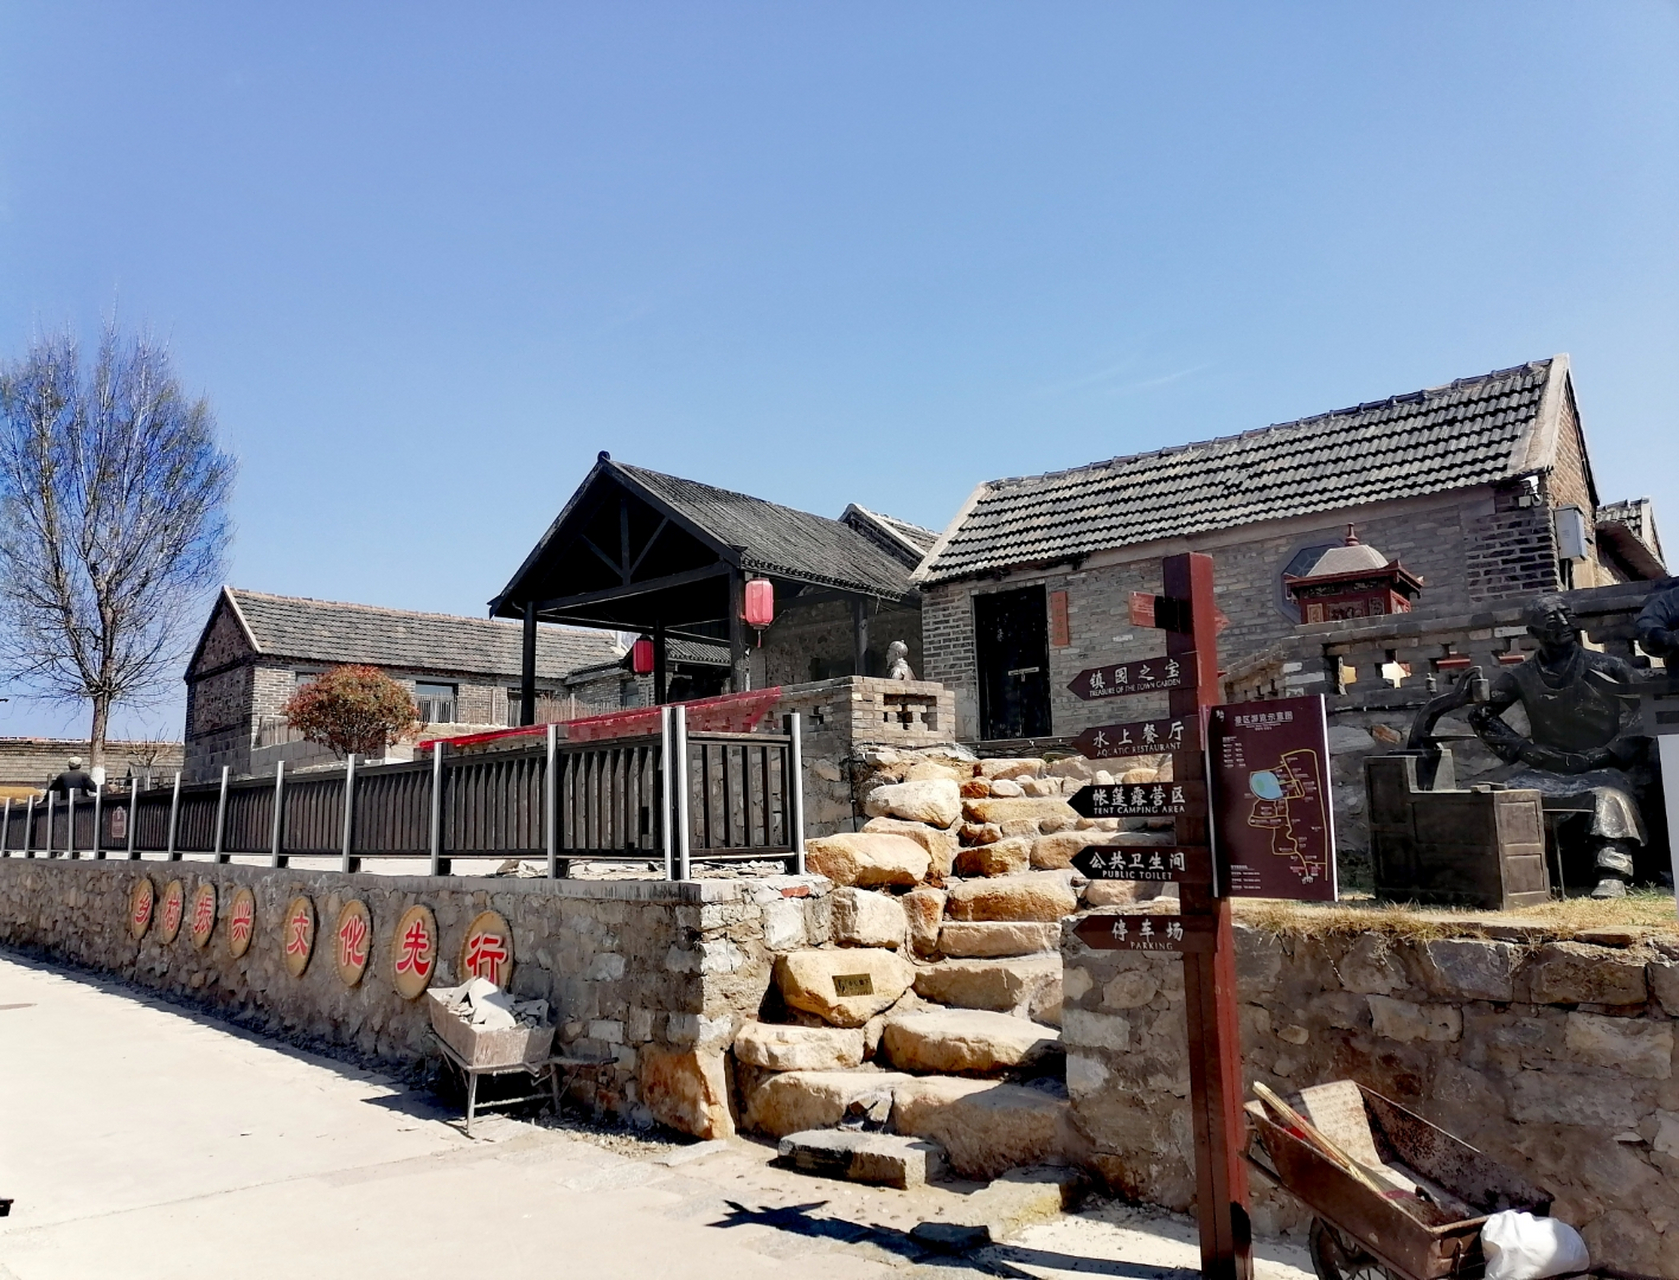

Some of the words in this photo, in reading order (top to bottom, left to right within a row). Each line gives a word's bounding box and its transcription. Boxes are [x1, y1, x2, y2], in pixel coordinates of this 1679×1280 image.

[1090, 686, 1115, 697] TREASURE
[1137, 682, 1155, 690] TOWN
[1156, 679, 1181, 687] GARDEN
[1093, 721, 1184, 748] 水上餐厅
[1132, 742, 1181, 753] RESTAURANT
[1092, 785, 1186, 806] 帐篷露营区
[1117, 806, 1158, 814] CAMPING
[1162, 805, 1185, 813] AREA
[1089, 850, 1186, 871] 公共卫生间
[1102, 870, 1135, 878] PUBLIC
[1140, 871, 1172, 880] TOILET
[1111, 919, 1184, 942] 停车场
[1130, 941, 1173, 950] PARKING
